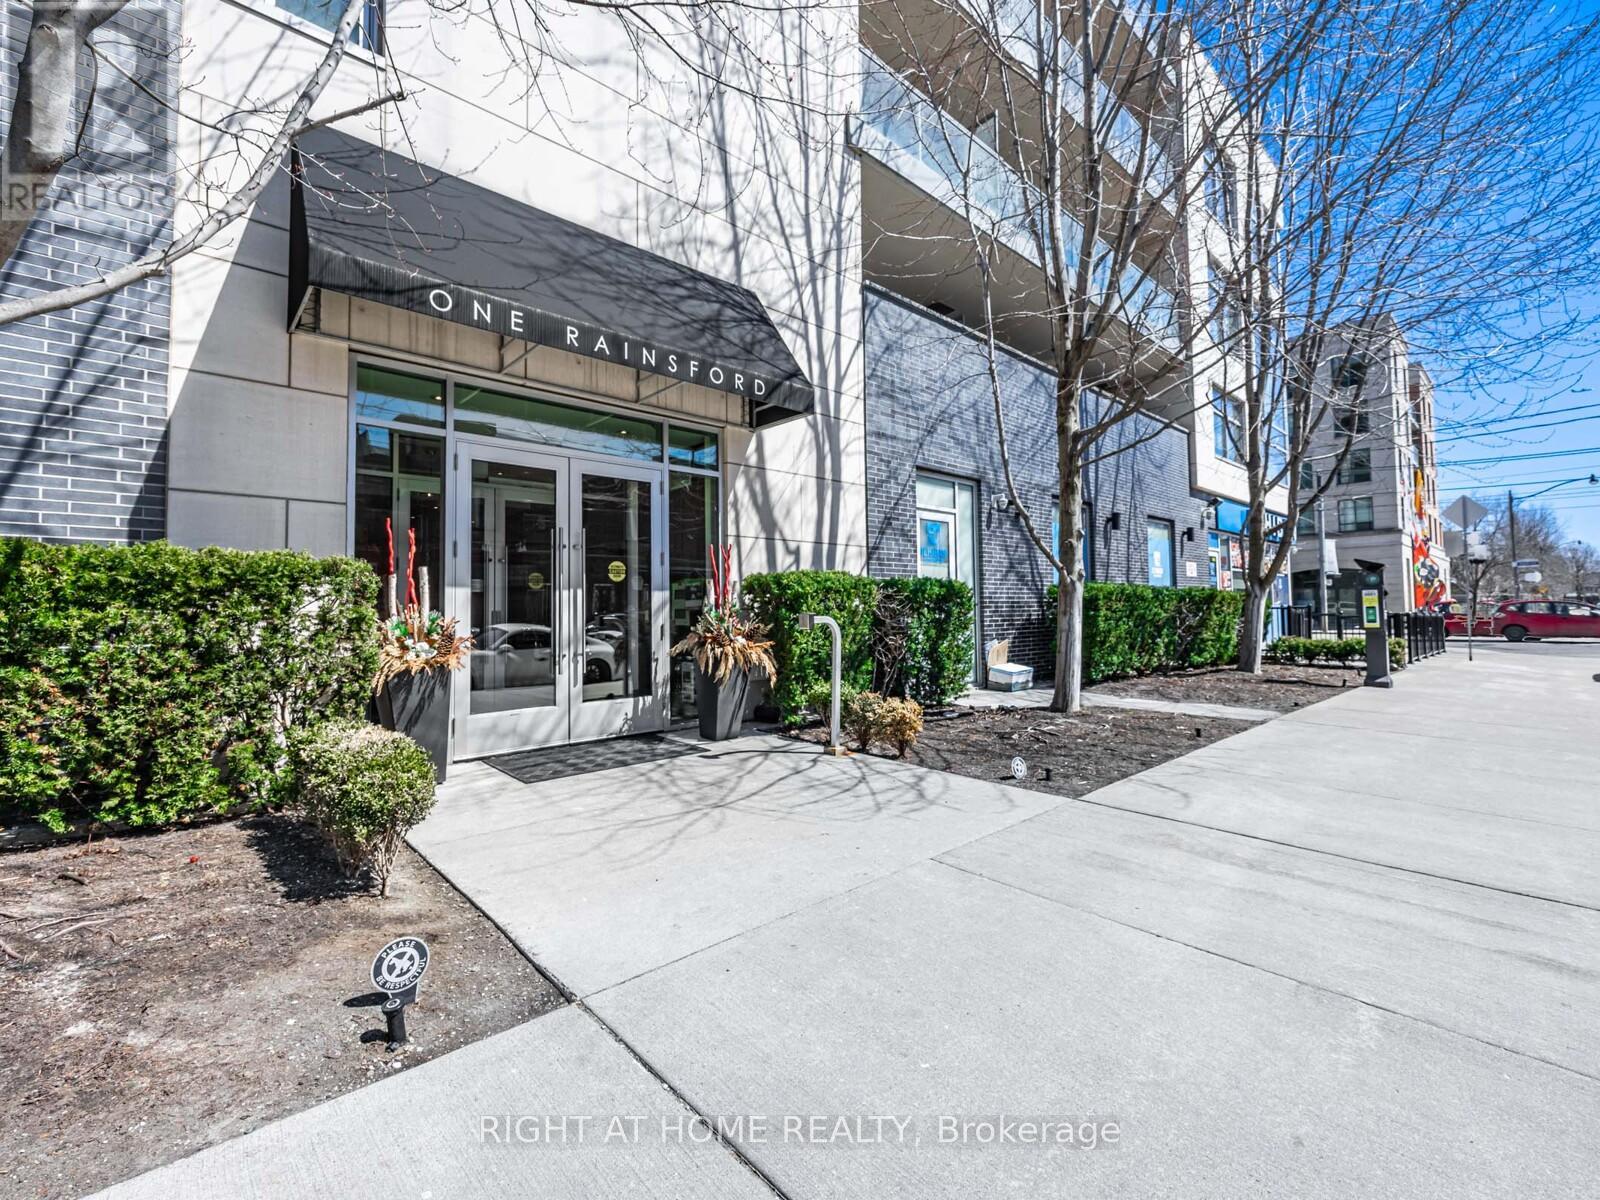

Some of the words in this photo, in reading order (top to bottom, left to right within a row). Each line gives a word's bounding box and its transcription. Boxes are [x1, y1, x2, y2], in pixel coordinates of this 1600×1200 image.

[429, 289, 524, 332] ONE
[566, 325, 766, 396] RAINSFORD
[381, 940, 417, 959] PLEASE
[375, 975, 386, 986] BE
[384, 956, 427, 990] RESPECTFUL
